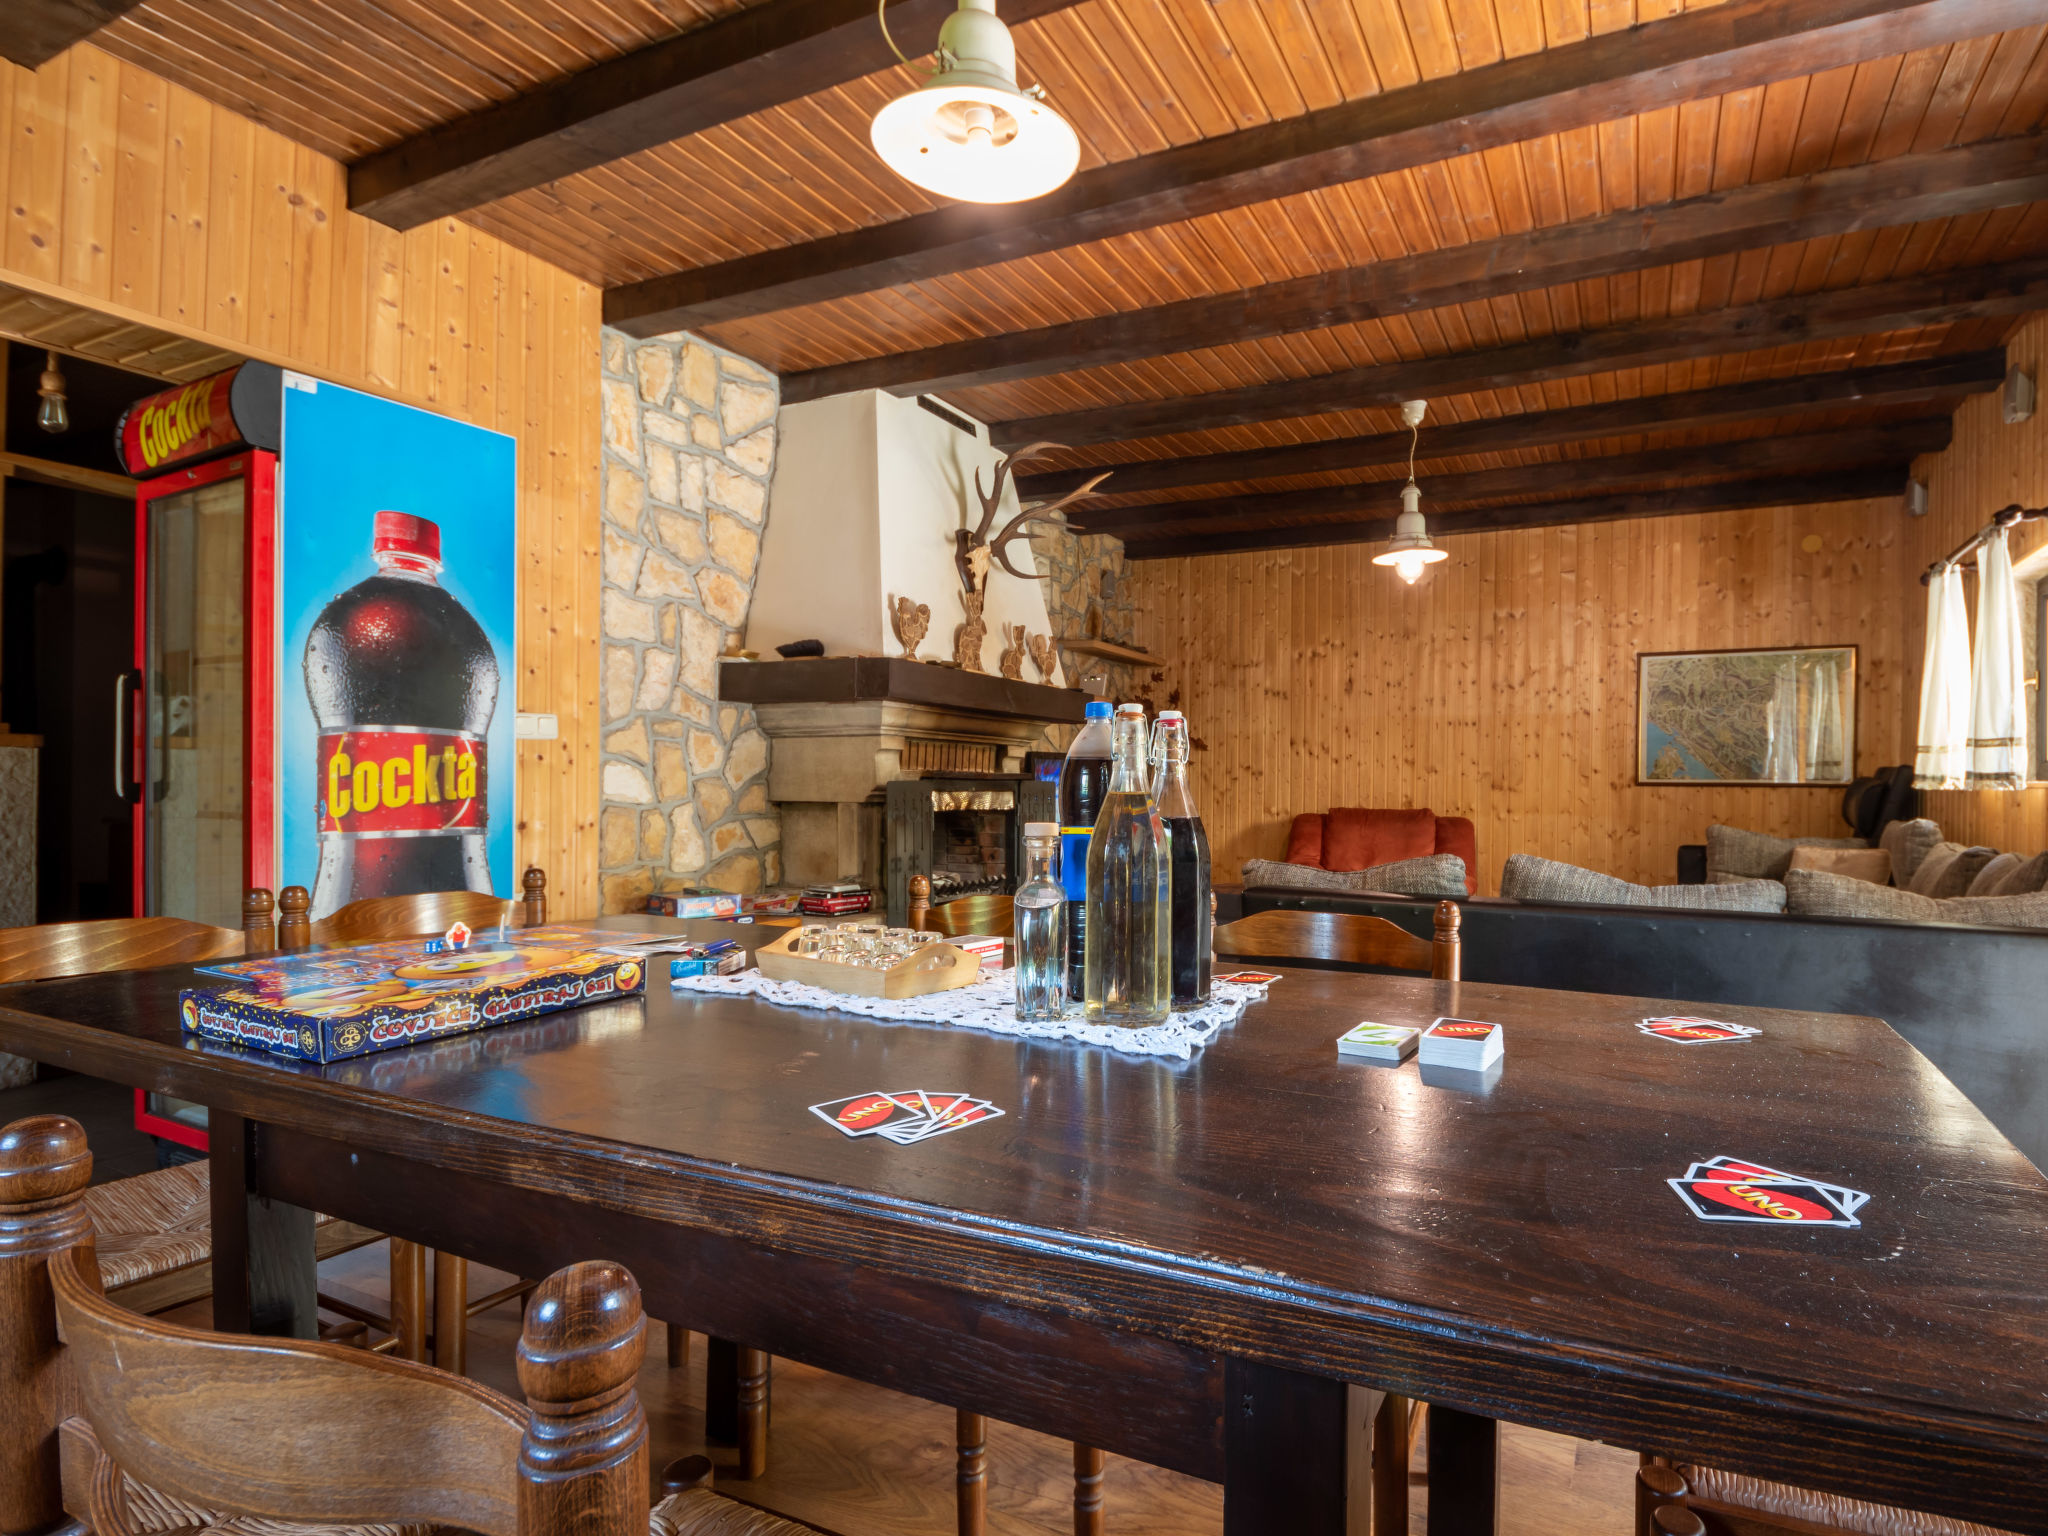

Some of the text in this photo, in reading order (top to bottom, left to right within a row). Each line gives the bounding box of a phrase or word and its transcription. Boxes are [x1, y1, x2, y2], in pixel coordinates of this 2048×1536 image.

[139, 379, 216, 468] Cockta
[328, 744, 477, 818] Cockta
[584, 973, 614, 997] SE!
[1436, 1025, 1492, 1034] UNO
[1671, 1028, 1724, 1039] UNO
[835, 1101, 894, 1122] UNO
[1727, 1185, 1803, 1220] UNO
